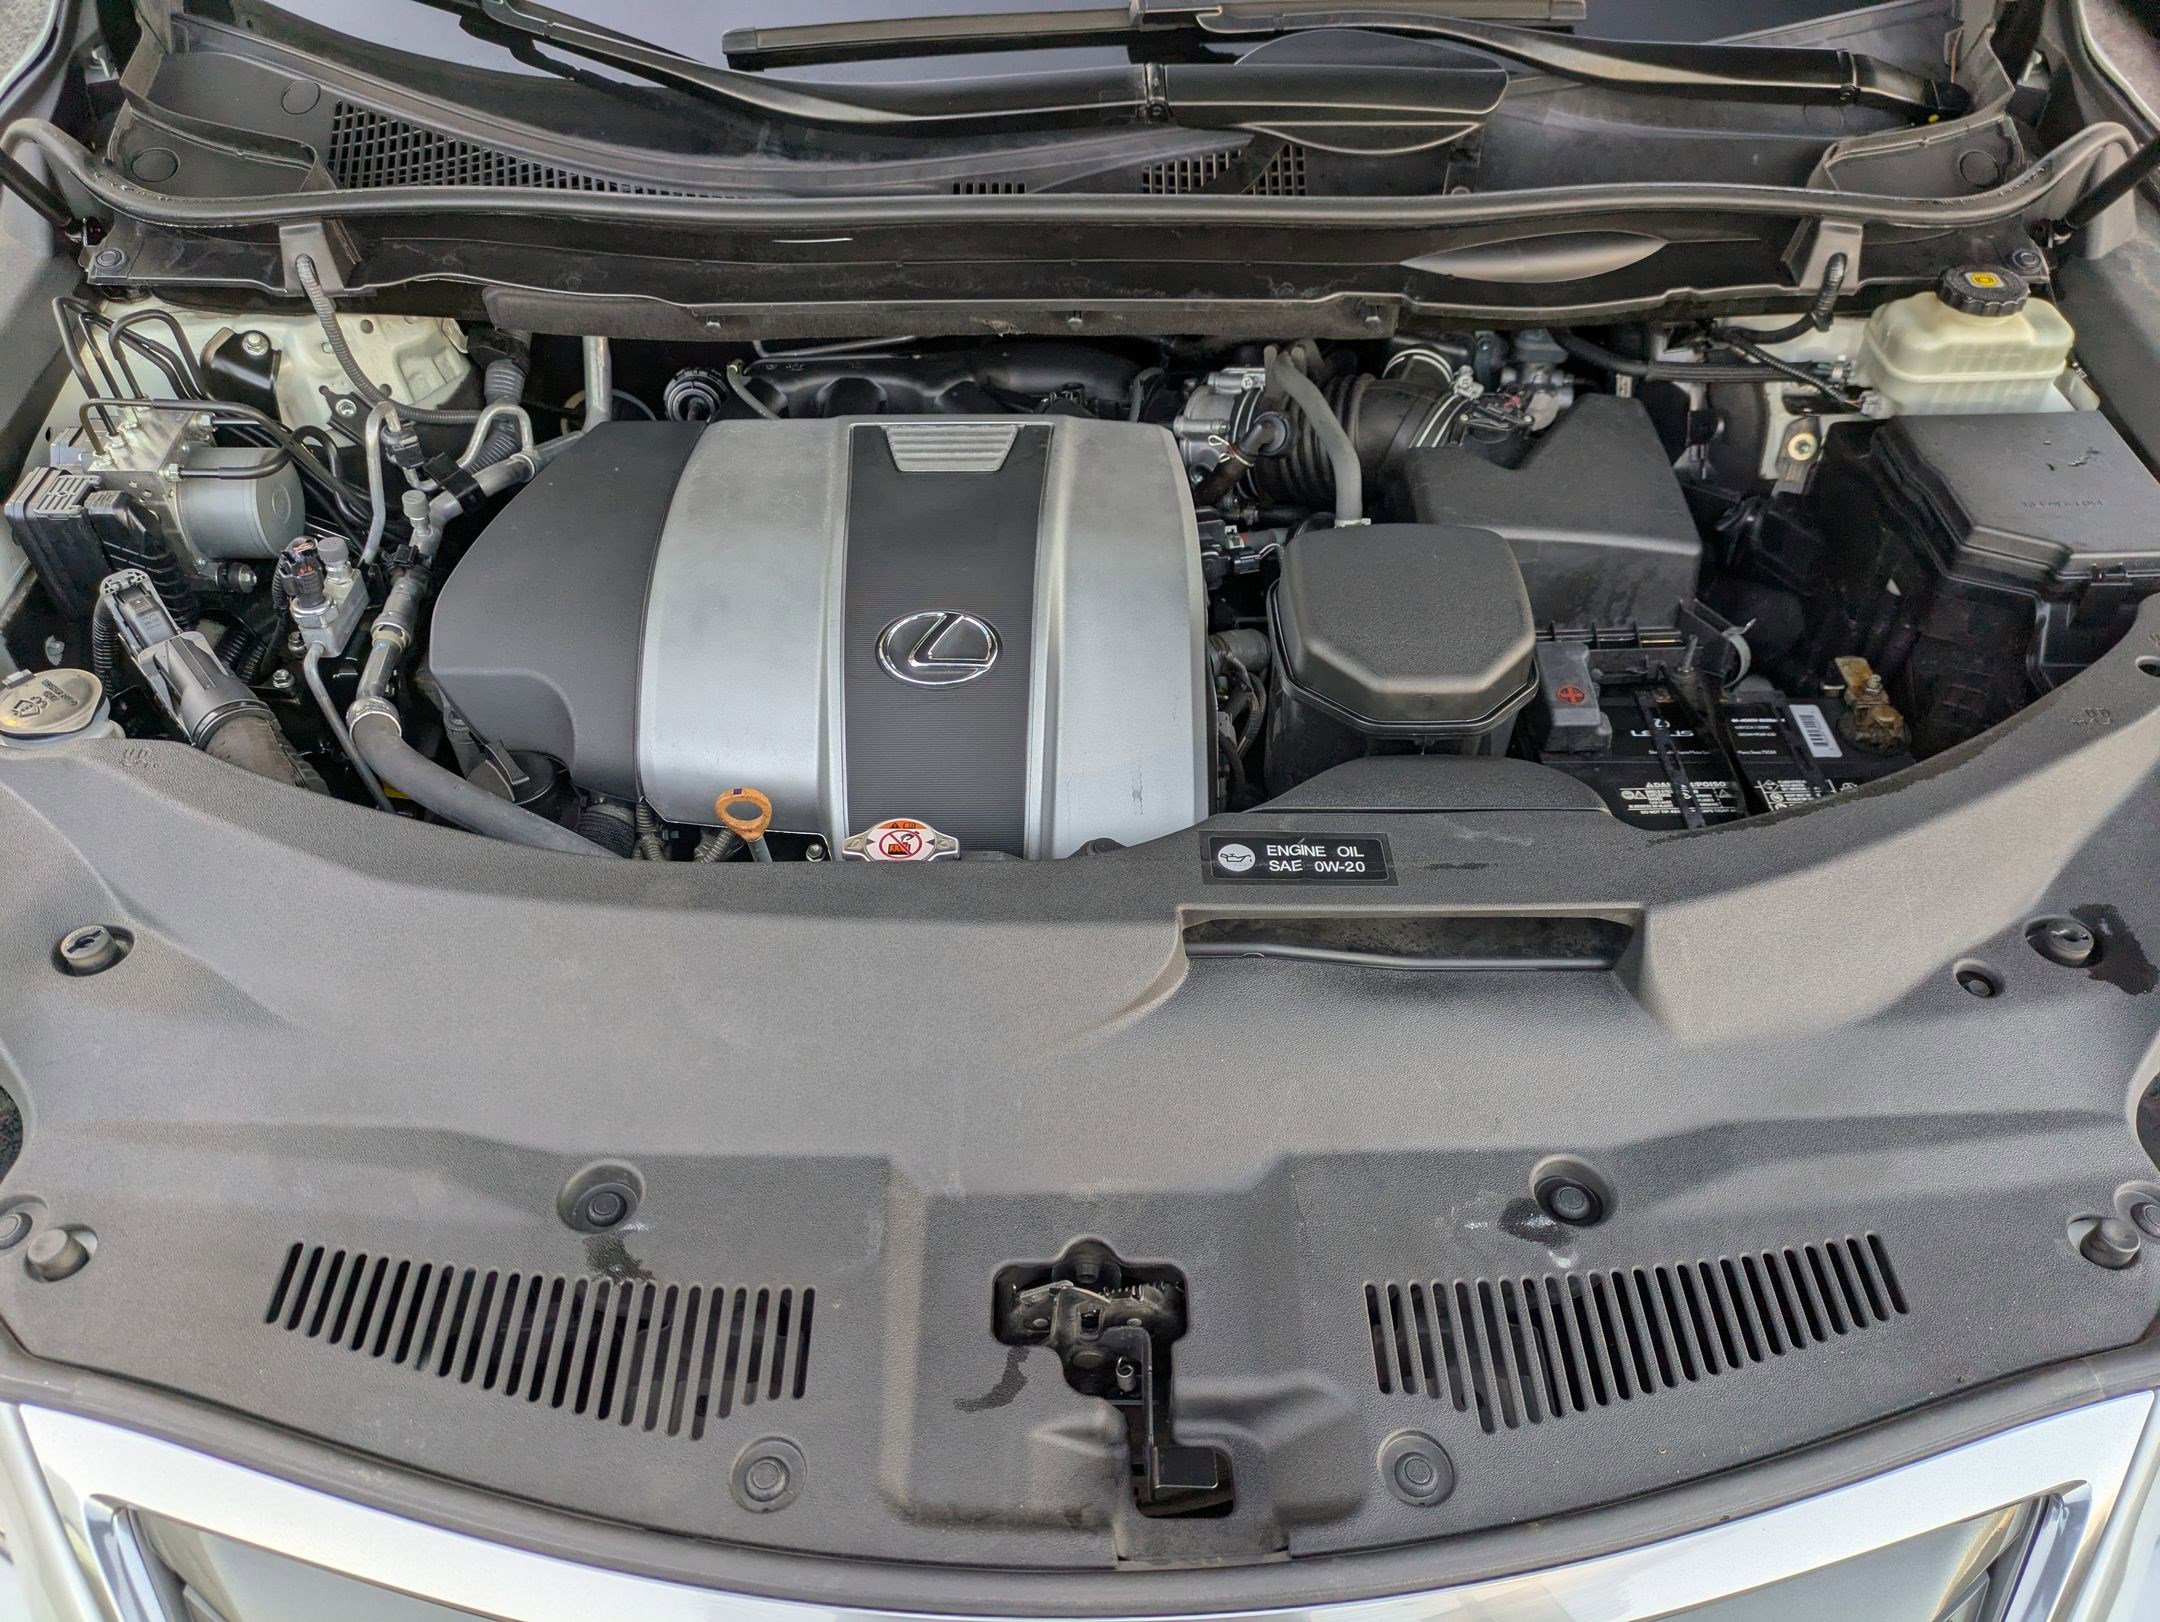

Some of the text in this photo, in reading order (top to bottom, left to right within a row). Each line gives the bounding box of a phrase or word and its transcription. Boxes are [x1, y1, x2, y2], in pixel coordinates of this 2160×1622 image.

[1630, 729, 1695, 737] LEUS
[1266, 844, 1365, 858] ENGINE OIL
[1269, 859, 1366, 873] SAE 0W-20
